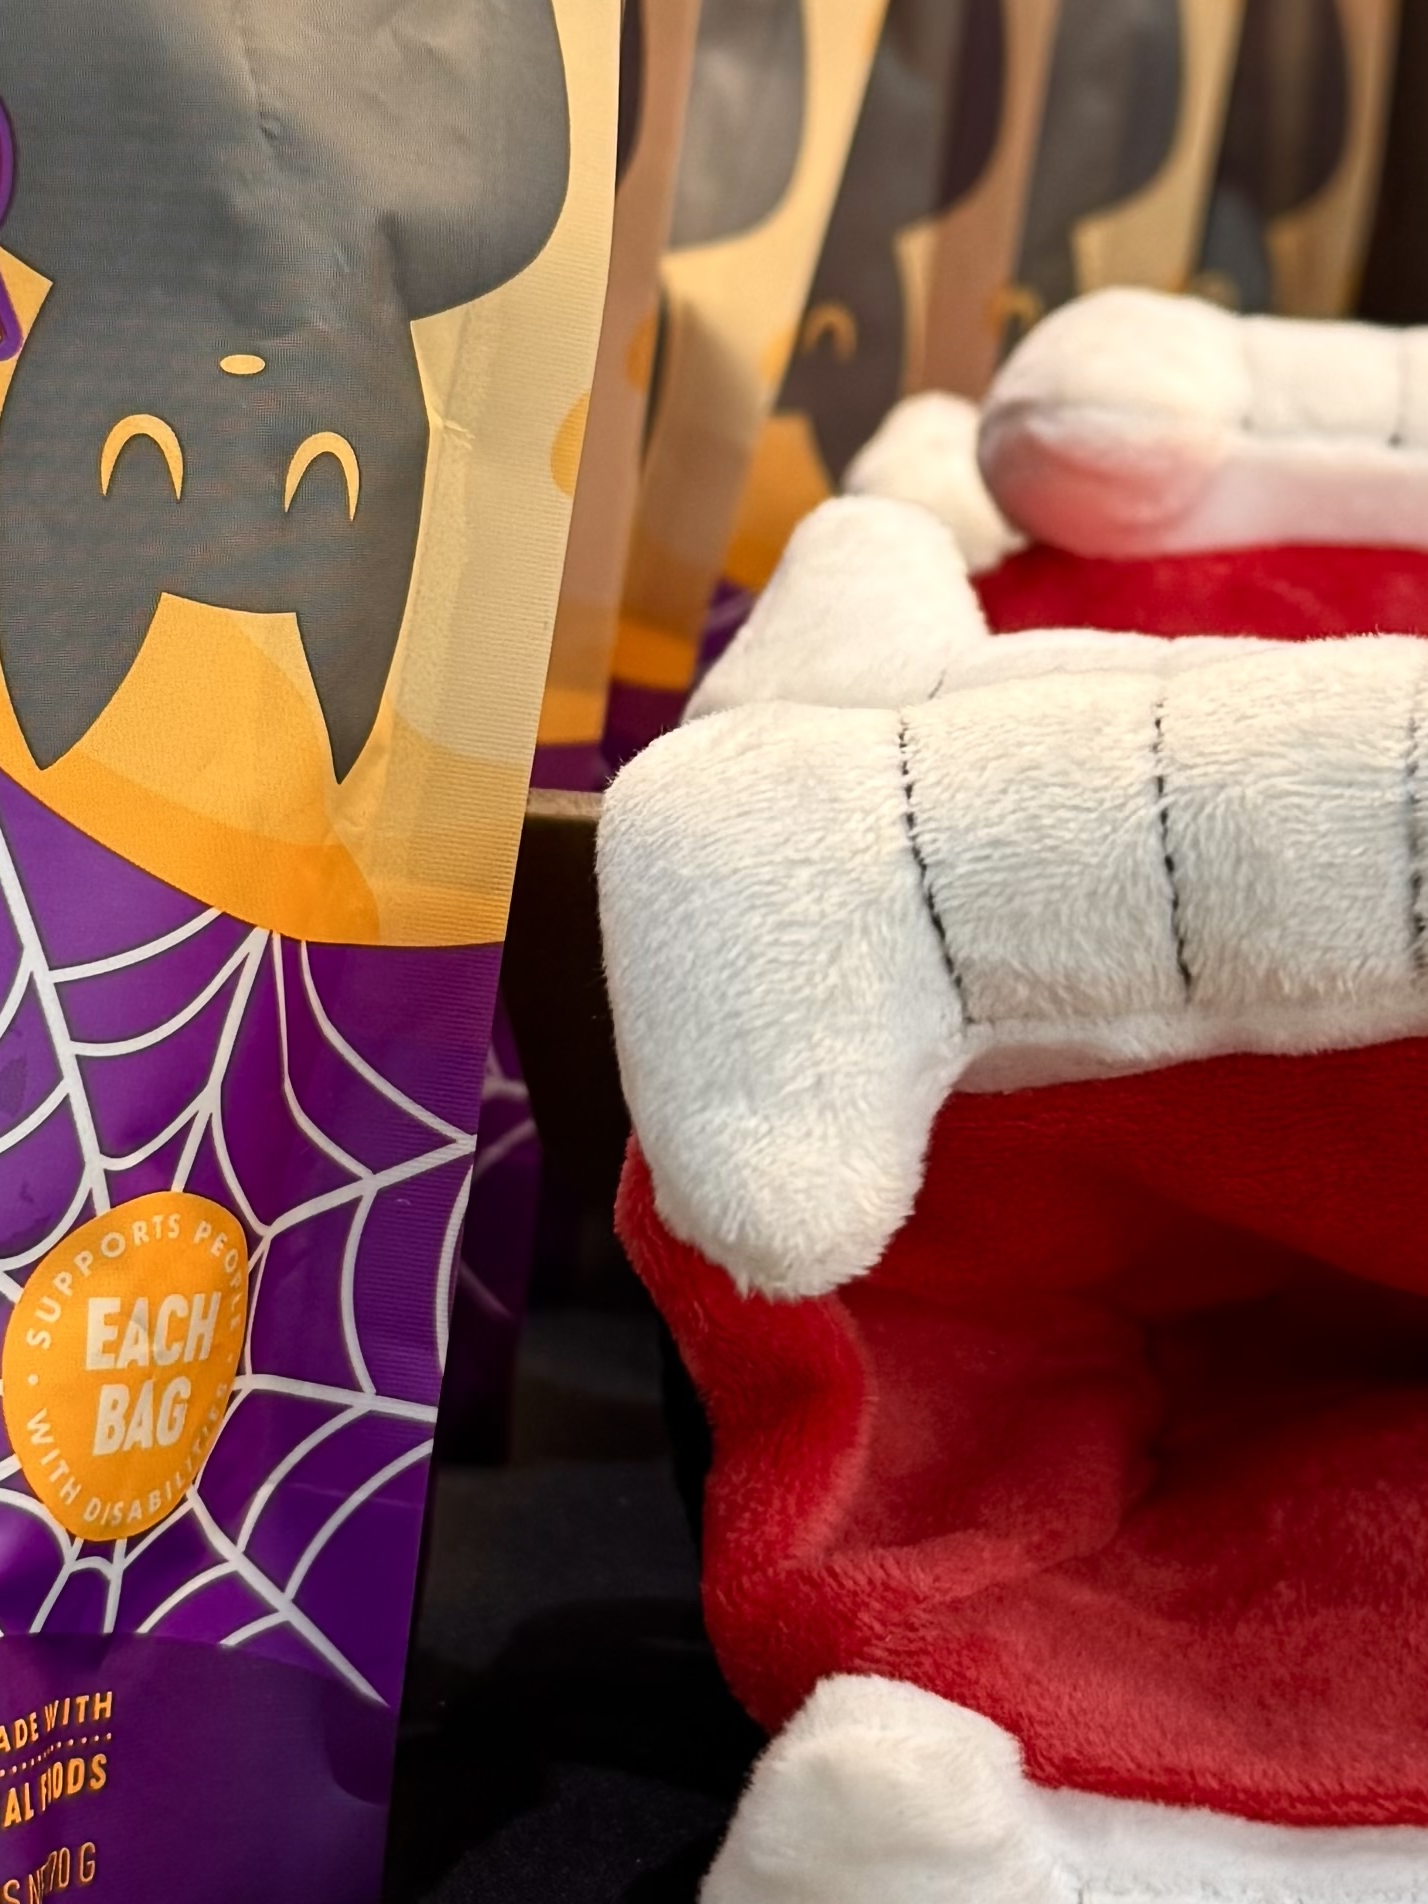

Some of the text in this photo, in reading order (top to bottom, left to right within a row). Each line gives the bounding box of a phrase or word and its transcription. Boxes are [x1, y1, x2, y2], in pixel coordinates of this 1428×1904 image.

[26, 1213, 180, 1350] SUPPORTS
[85, 1291, 222, 1371] EACH
[92, 1376, 192, 1456] BAG
[27, 1407, 83, 1506] WITH
[44, 1691, 113, 1733] WITH
[79, 1841, 96, 1884] G
